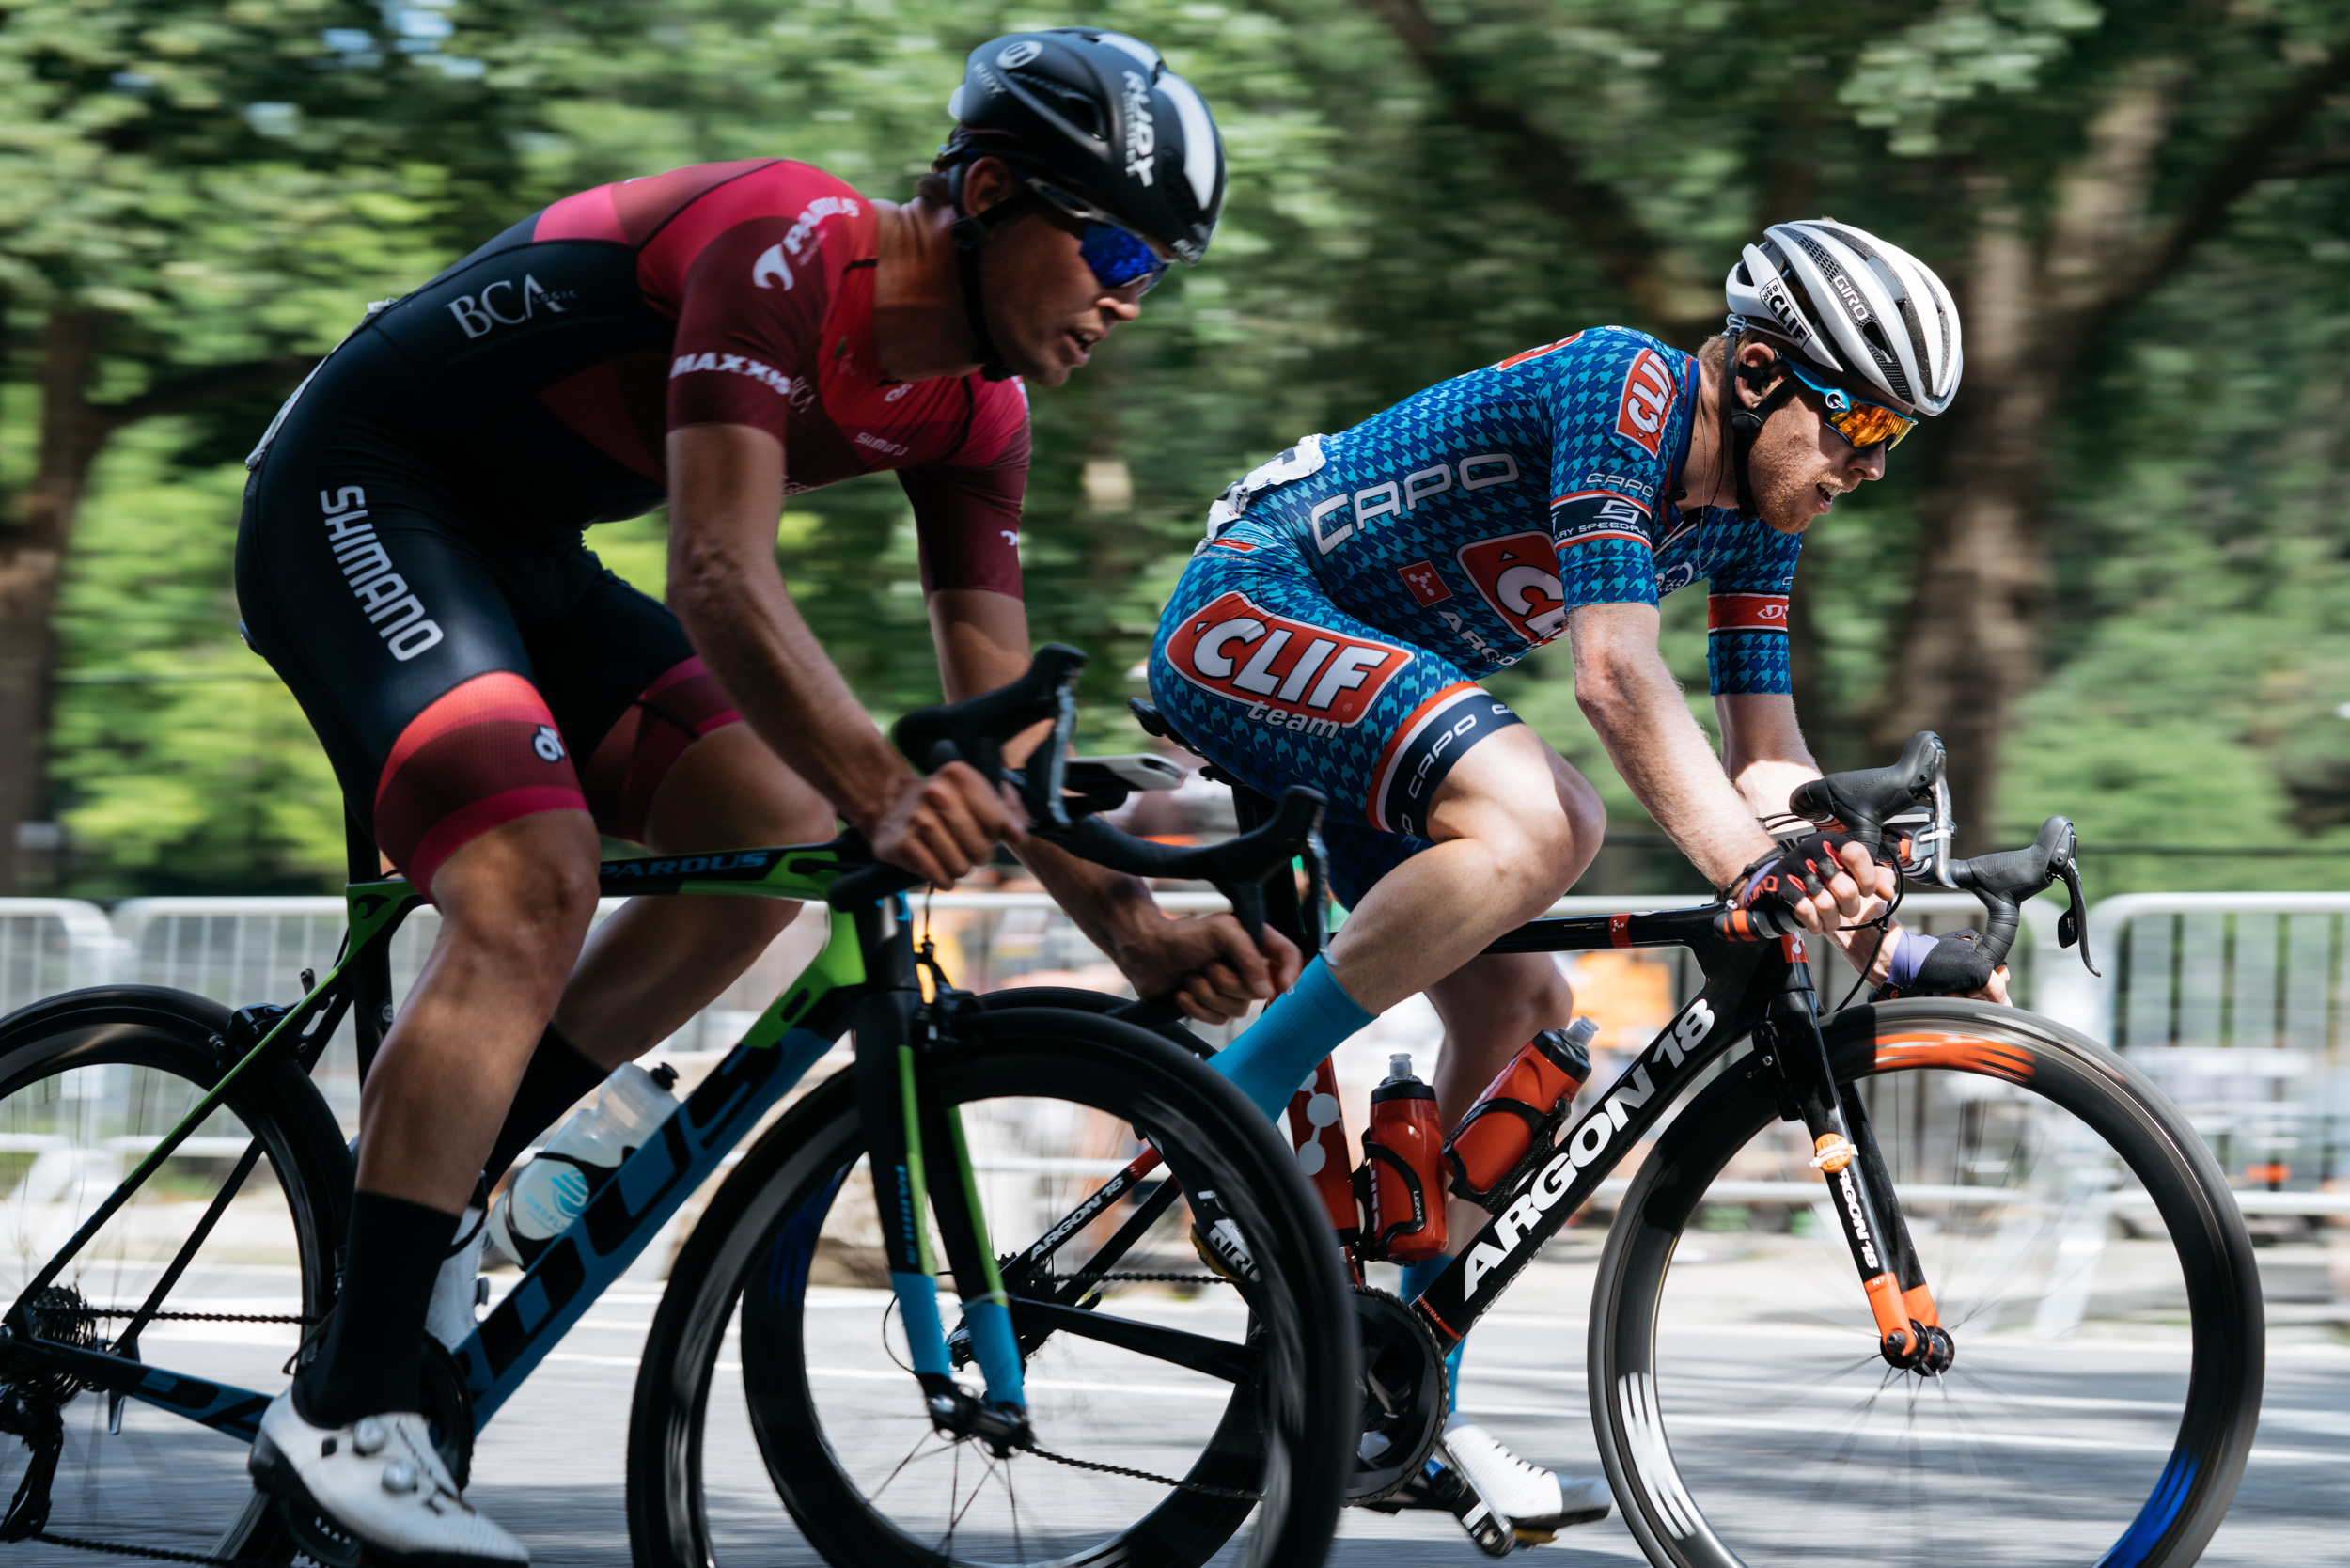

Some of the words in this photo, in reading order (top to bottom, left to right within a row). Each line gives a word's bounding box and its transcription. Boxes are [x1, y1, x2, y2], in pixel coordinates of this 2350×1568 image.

[444, 273, 566, 339] BCA
[1763, 285, 1779, 302] BAR
[1770, 295, 1807, 341] CLIF
[1834, 274, 1869, 321] GIRO
[669, 352, 791, 396] MAXXIS
[1310, 453, 1520, 557] CAPO
[1586, 473, 1654, 498] CAPO
[320, 485, 444, 662] SHIMANO
[1193, 618, 1392, 712] CLIF
[1247, 698, 1340, 740] team
[1408, 713, 1477, 800] CAPO
[1465, 1062, 1656, 1302] ARGON
[1652, 998, 1716, 1070] 18
[1030, 1195, 1103, 1262] ARGON
[1102, 1176, 1125, 1197] 18
[1838, 1168, 1870, 1240] RGON
[1860, 1239, 1879, 1269] 18
[1872, 1276, 1885, 1287] N7
